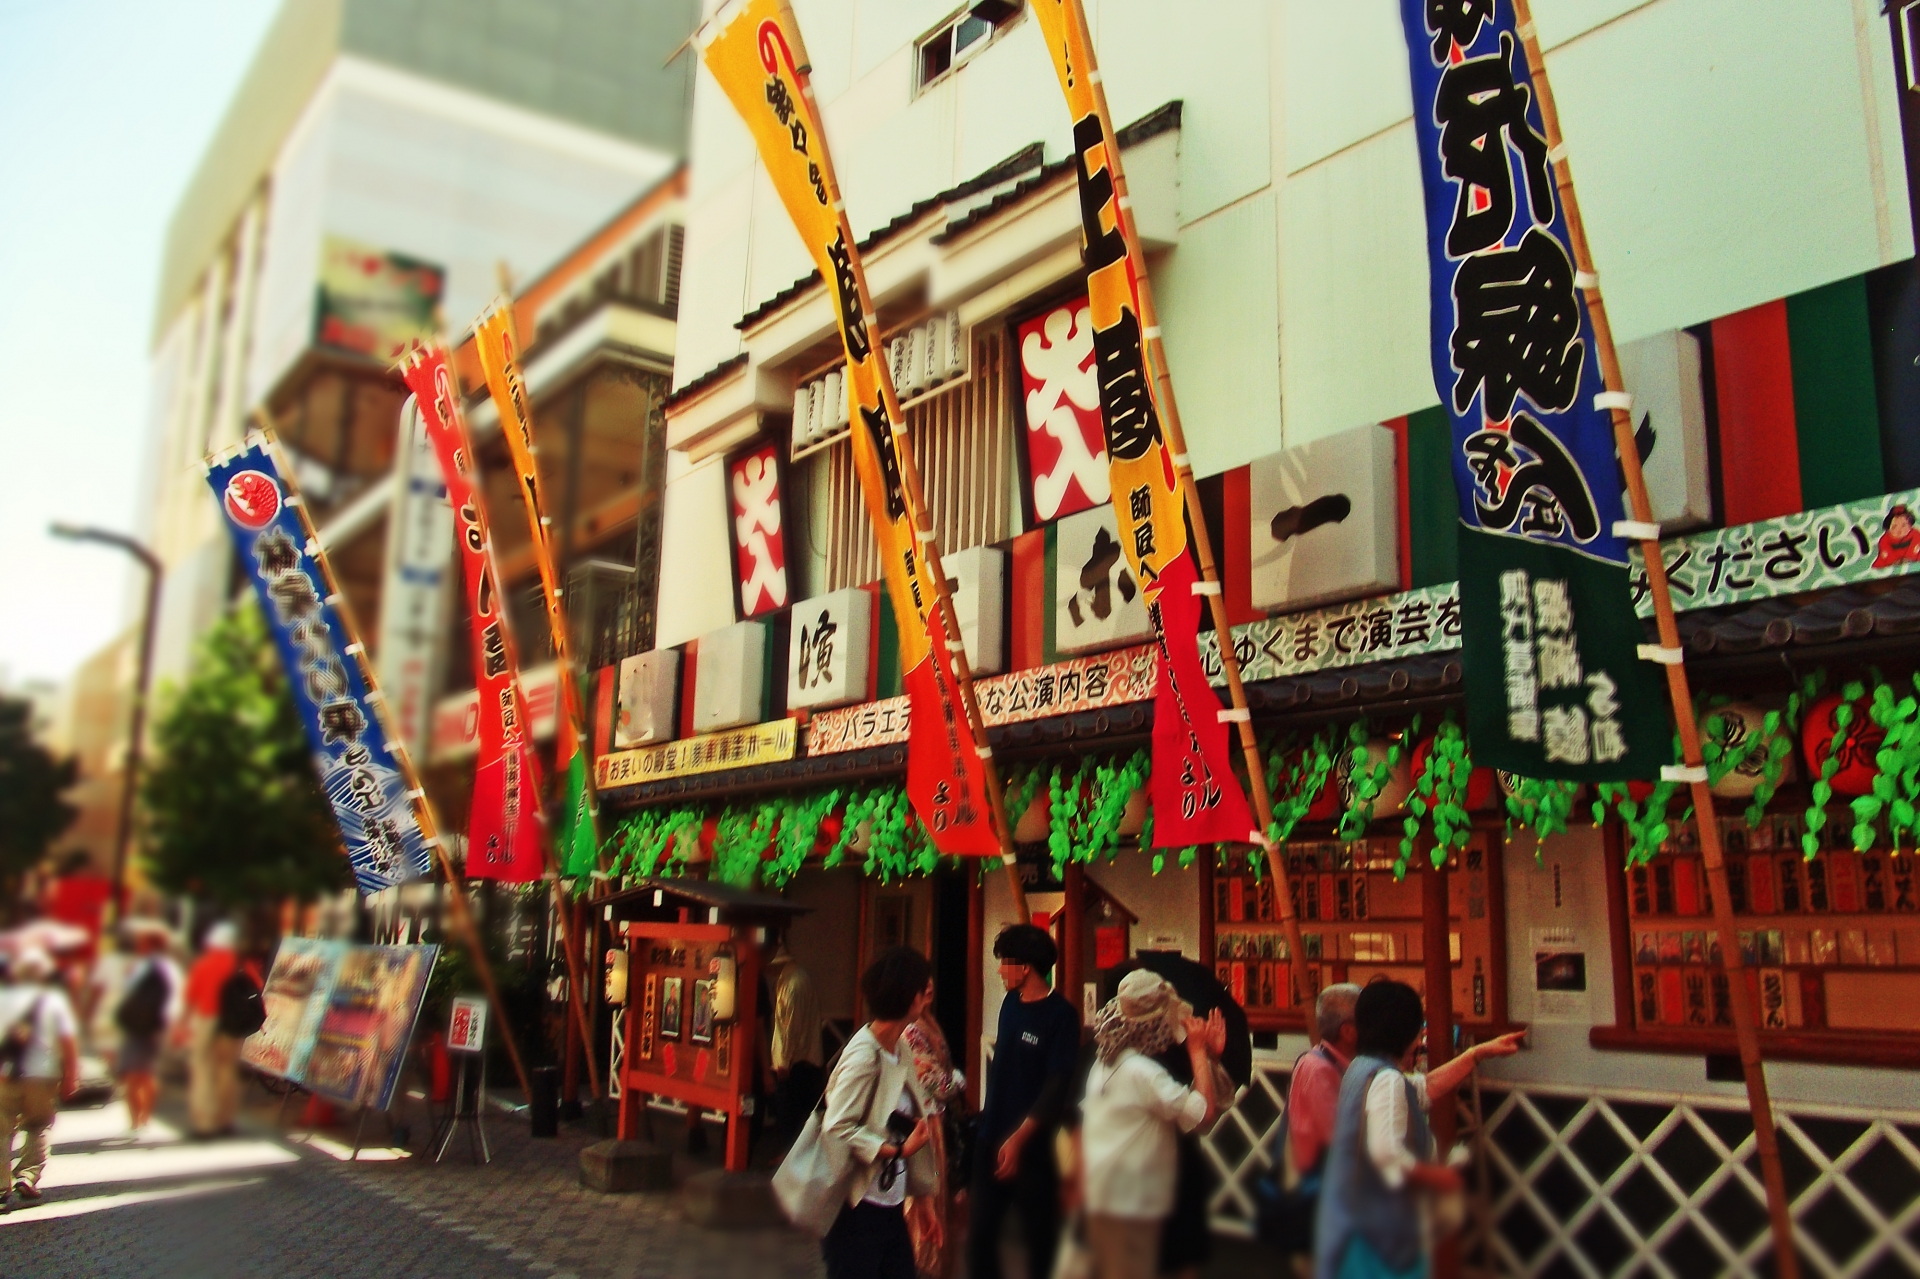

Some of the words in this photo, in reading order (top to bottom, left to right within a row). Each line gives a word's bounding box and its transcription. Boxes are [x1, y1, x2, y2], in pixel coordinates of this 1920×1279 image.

[1021, 307, 1111, 521] 大入
[733, 455, 788, 617] 大入
[1127, 483, 1159, 582] 師匠へ
[975, 664, 1110, 716] な公演内容
